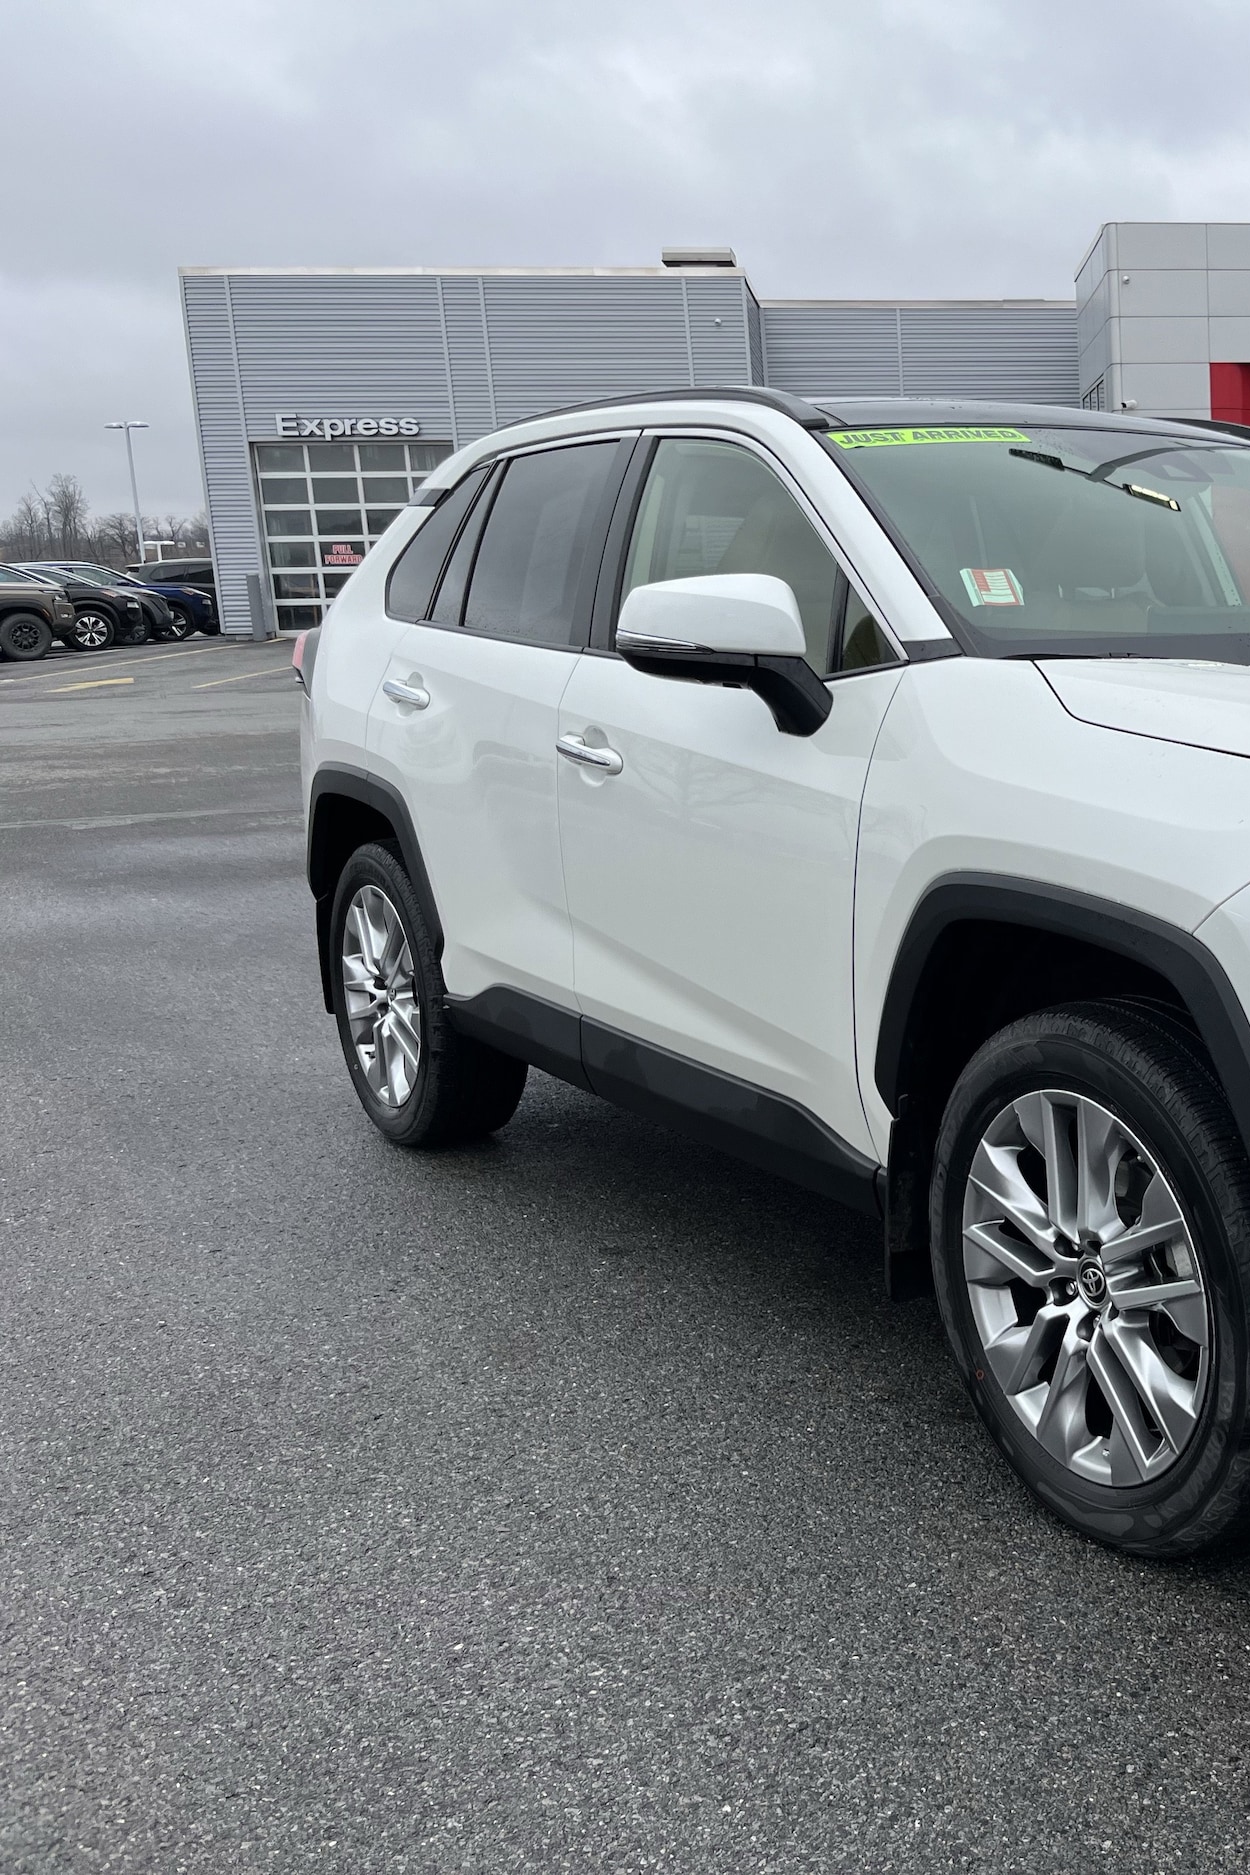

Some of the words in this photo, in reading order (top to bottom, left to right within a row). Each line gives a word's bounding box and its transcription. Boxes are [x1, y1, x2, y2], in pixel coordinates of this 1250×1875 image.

[275, 413, 420, 441] Express
[840, 430, 902, 445] JUST
[911, 428, 1019, 441] ARRIVED
[332, 544, 354, 554] PULL
